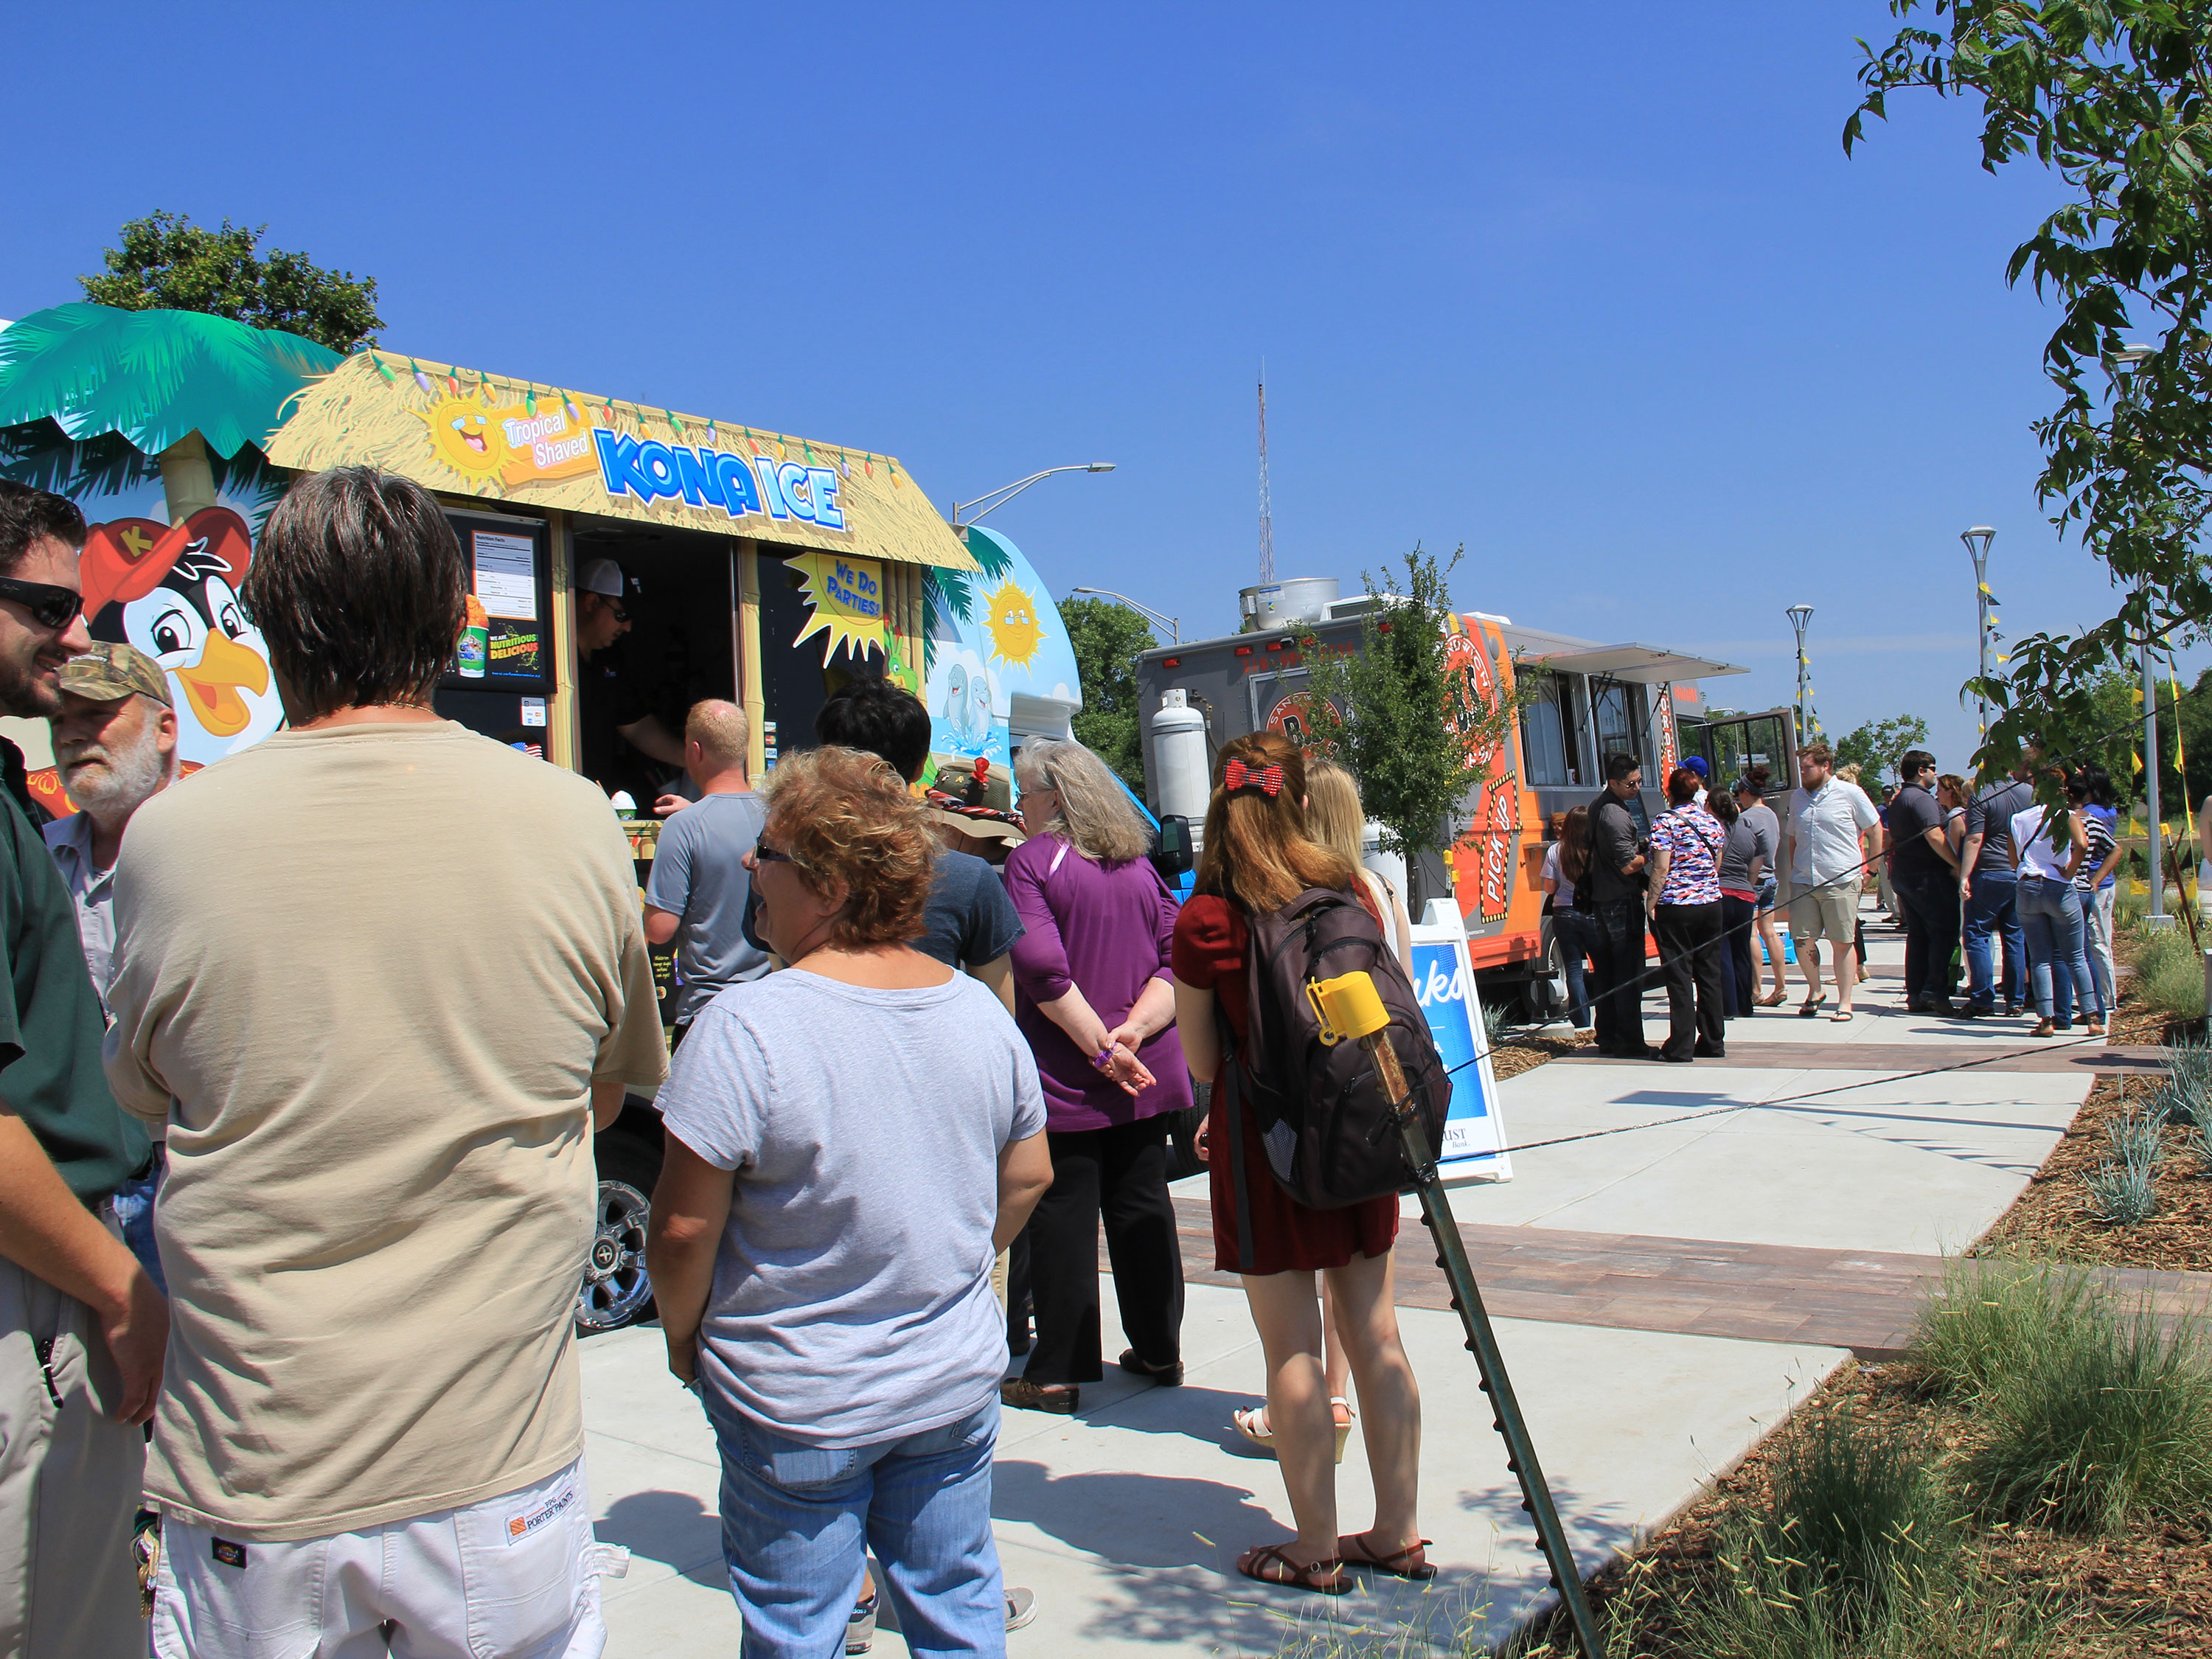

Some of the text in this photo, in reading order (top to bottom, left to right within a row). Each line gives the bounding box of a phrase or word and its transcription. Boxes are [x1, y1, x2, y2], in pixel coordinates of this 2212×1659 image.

[505, 408, 566, 445] Tropical
[535, 431, 589, 466] Shaved
[592, 428, 846, 532] KONA ICE
[120, 526, 153, 557] K
[490, 633, 537, 649] NUTRITIOUS
[490, 642, 538, 660] DELICIOUS
[1487, 794, 1510, 903] PICK UP
[1443, 1128, 1466, 1141] UST
[526, 1490, 574, 1529] PORTER PAINTS
[545, 1497, 557, 1508] PPG
